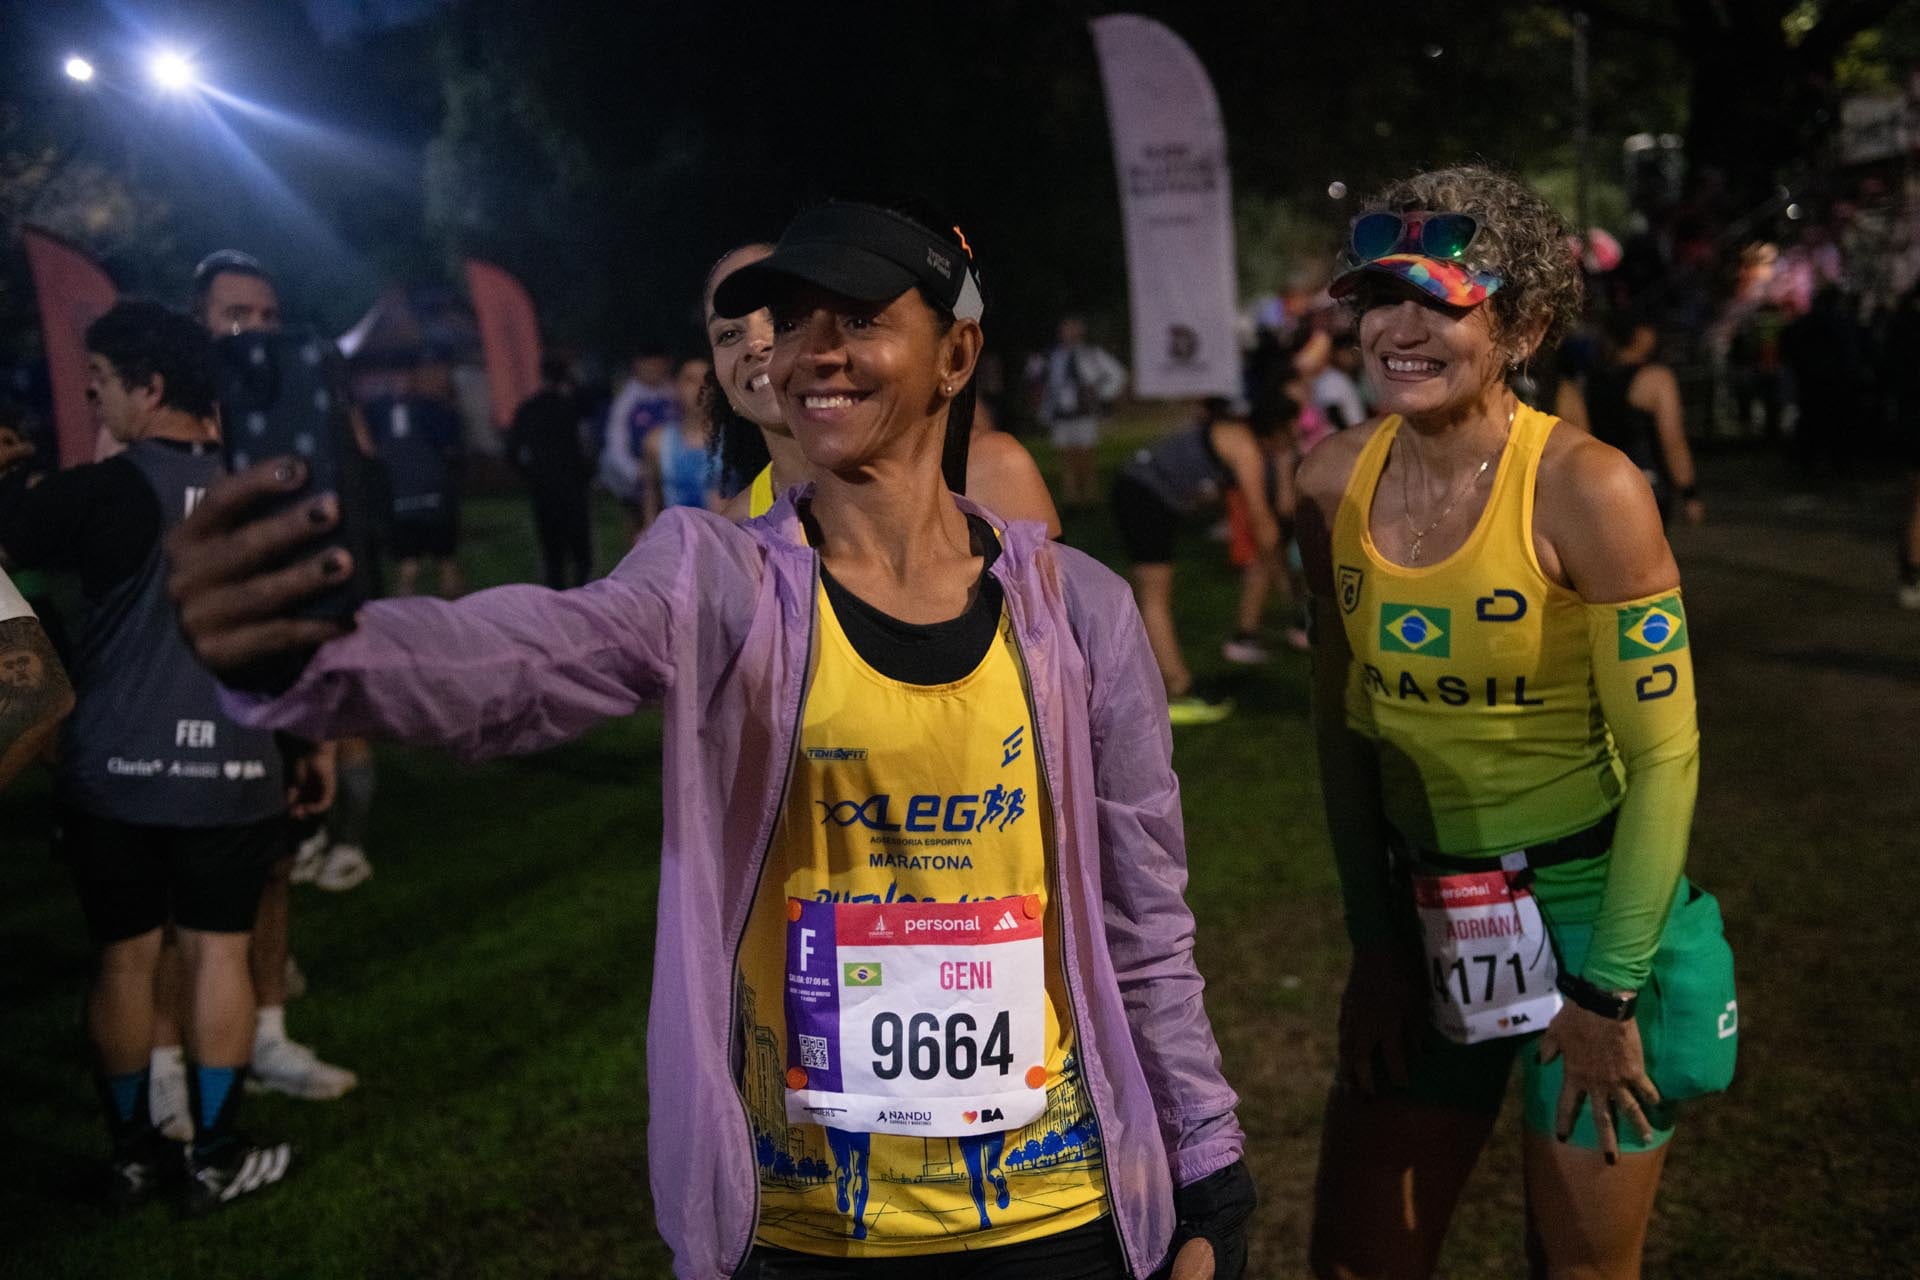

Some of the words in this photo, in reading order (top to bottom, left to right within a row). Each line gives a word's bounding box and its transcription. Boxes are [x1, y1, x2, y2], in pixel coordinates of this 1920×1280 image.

[1362, 662, 1545, 707] RASIL
[175, 718, 217, 748] FER
[924, 838, 973, 847] ESPORTIVA
[869, 853, 973, 871] MARATONA
[905, 915, 980, 934] personal
[1446, 915, 1524, 940] ADRIANA
[801, 928, 816, 972] F
[940, 961, 993, 990] GENI
[871, 1010, 1014, 1081] 9664
[981, 1108, 1004, 1123] BA
